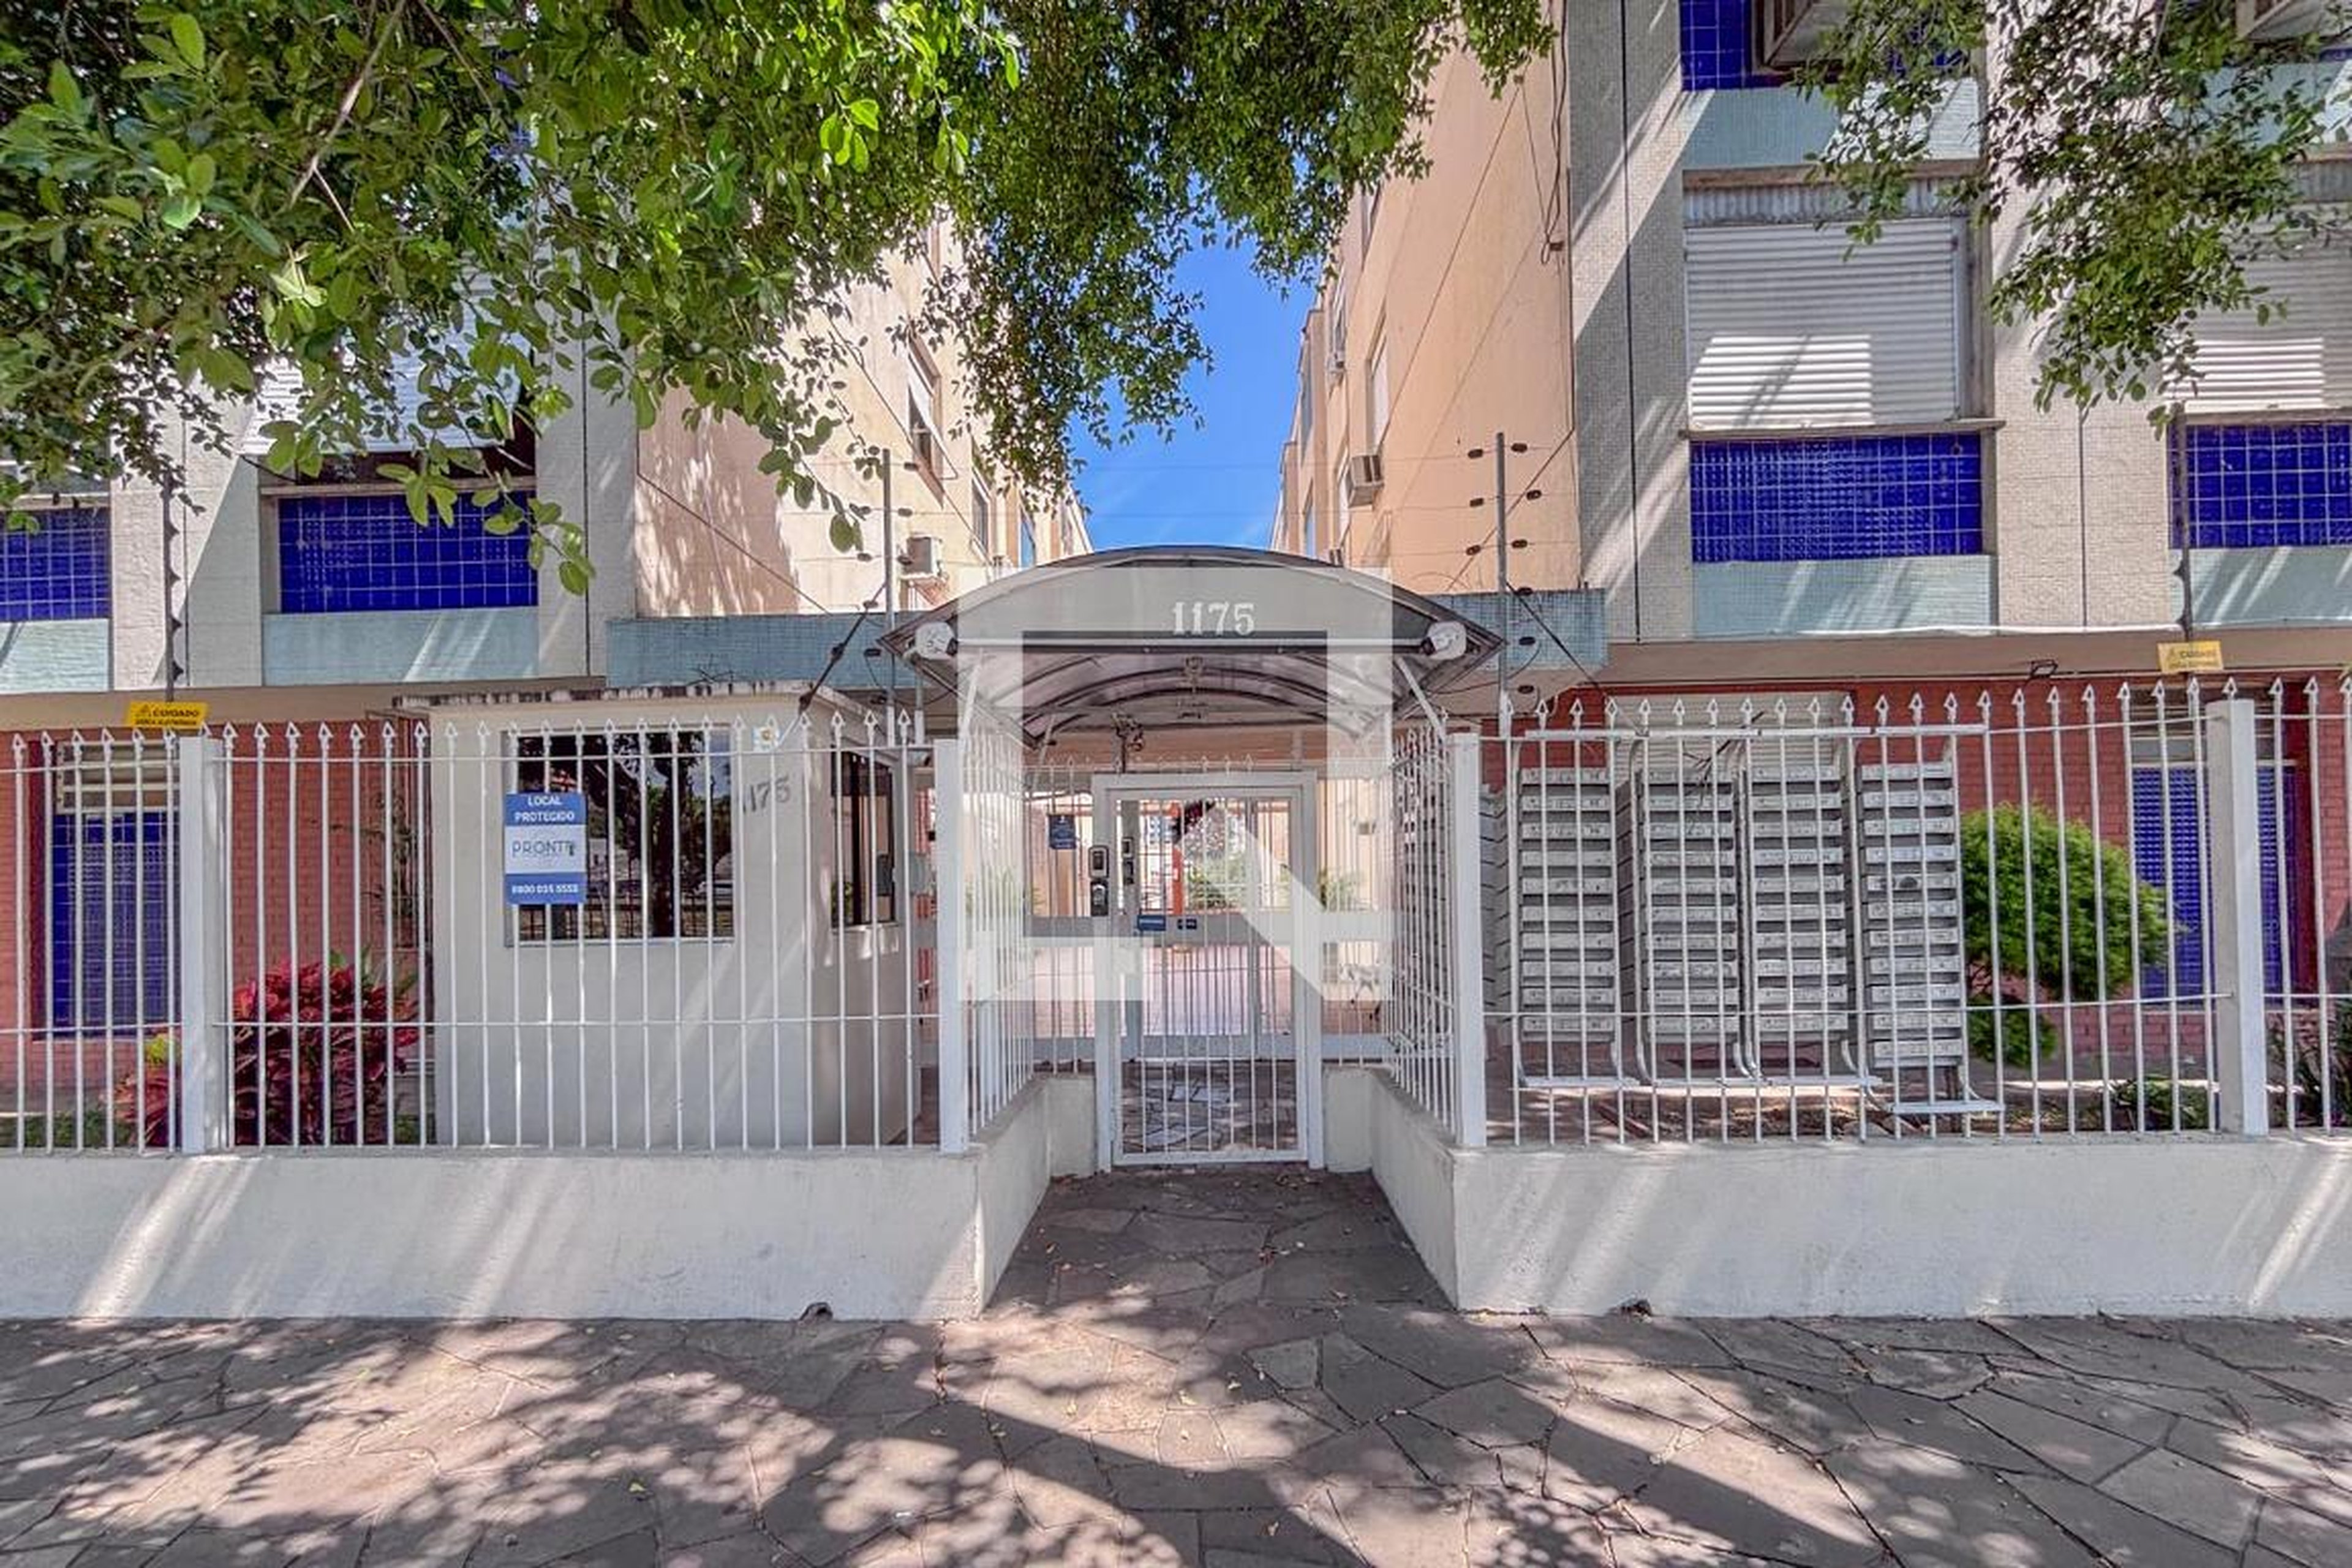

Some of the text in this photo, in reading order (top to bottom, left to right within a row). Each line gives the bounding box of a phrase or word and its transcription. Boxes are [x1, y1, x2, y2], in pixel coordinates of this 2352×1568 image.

[1172, 601, 1254, 635] 1175
[527, 795, 562, 806] LOCAL
[514, 810, 575, 822] PROTEGIDO
